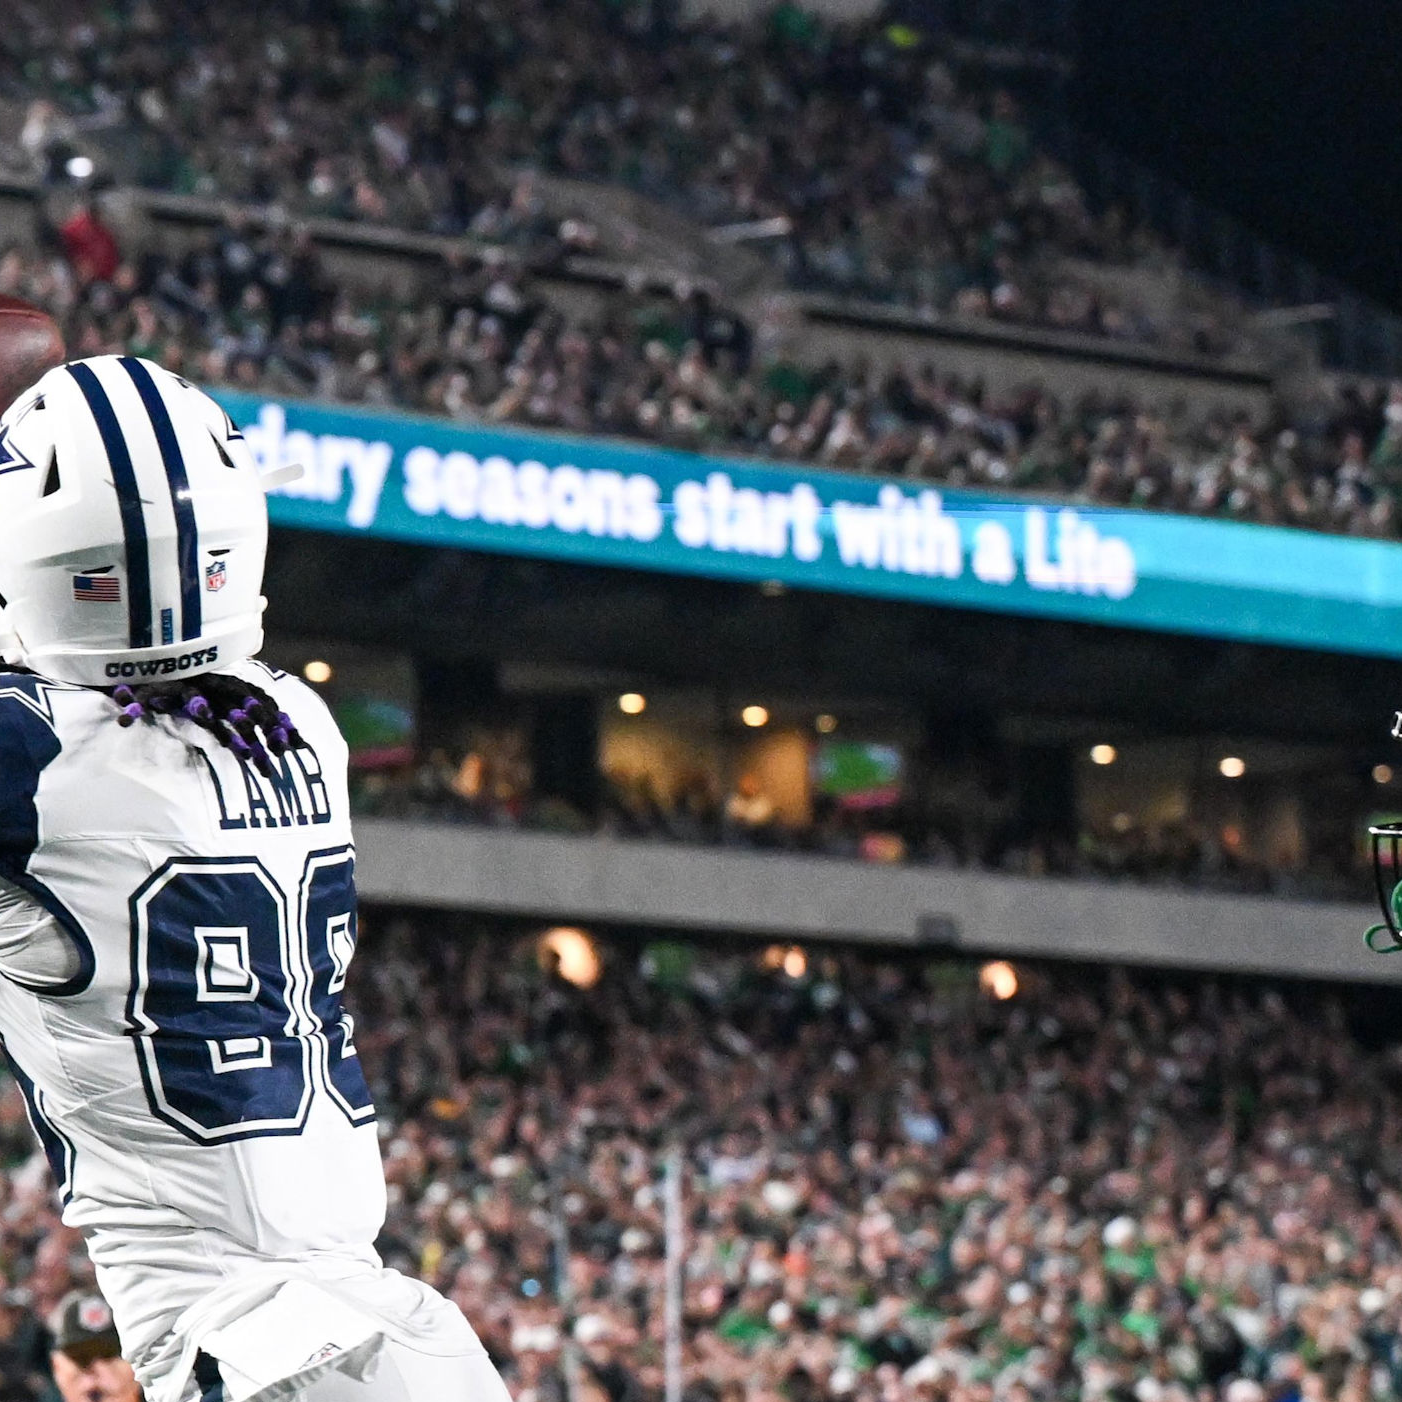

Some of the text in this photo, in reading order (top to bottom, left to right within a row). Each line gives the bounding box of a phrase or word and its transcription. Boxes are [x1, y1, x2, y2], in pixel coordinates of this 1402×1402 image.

[402, 446, 663, 544] seasons
[673, 471, 823, 562] start
[831, 484, 963, 580] with
[972, 520, 1016, 586] a
[1025, 507, 1137, 600] Lite
[105, 645, 218, 678] COWBOYS
[194, 742, 331, 830] LAMB
